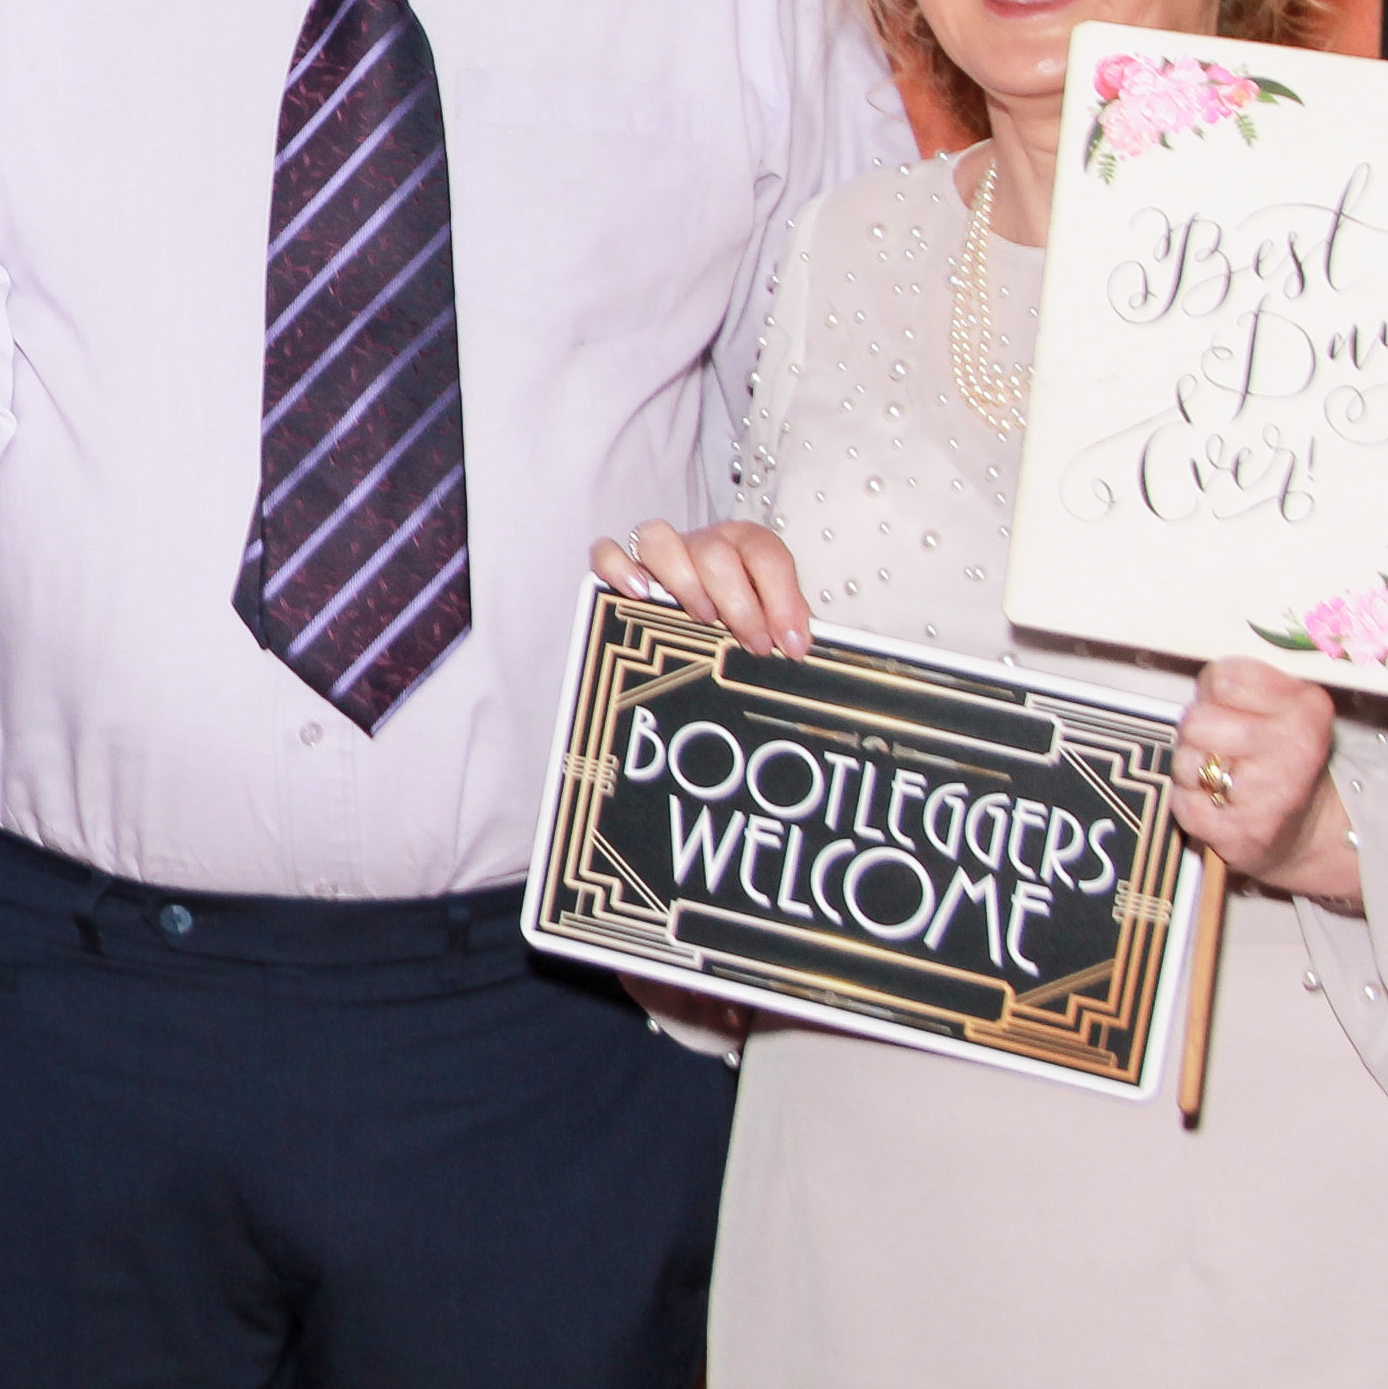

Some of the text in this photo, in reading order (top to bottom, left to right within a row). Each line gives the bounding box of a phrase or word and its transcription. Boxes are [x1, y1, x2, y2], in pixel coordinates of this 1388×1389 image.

[1106, 162, 1388, 324] Best
[623, 704, 1117, 894] BOOTLEGGERS
[667, 793, 1054, 978] WELCOME
